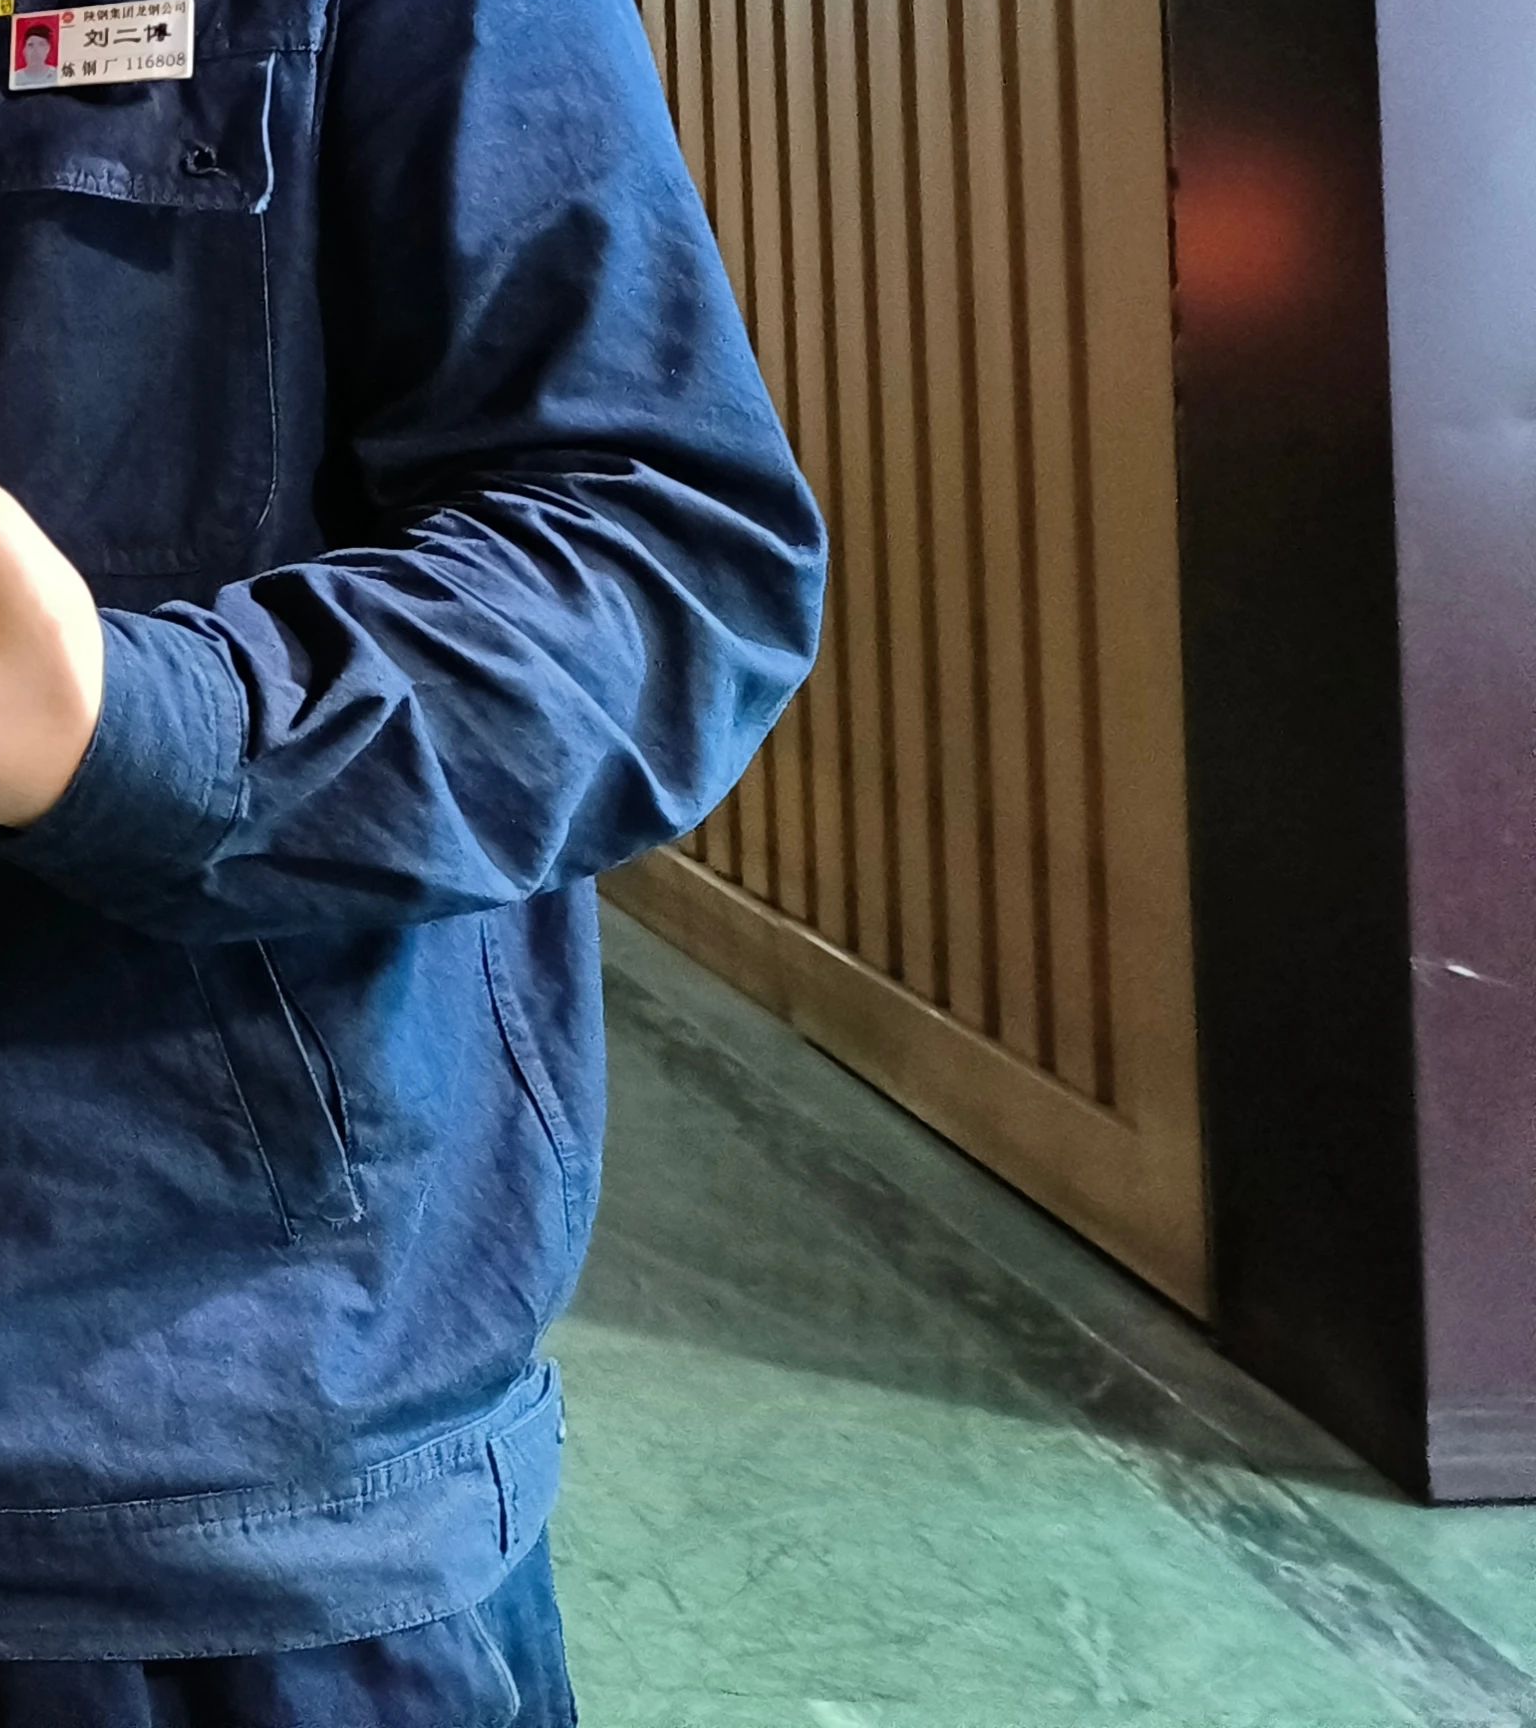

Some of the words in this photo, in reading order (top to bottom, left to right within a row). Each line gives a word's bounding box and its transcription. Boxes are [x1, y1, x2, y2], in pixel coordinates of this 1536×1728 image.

[83, 2, 186, 22] 陕钢集团龙钢公司
[127, 53, 186, 71] 116808
